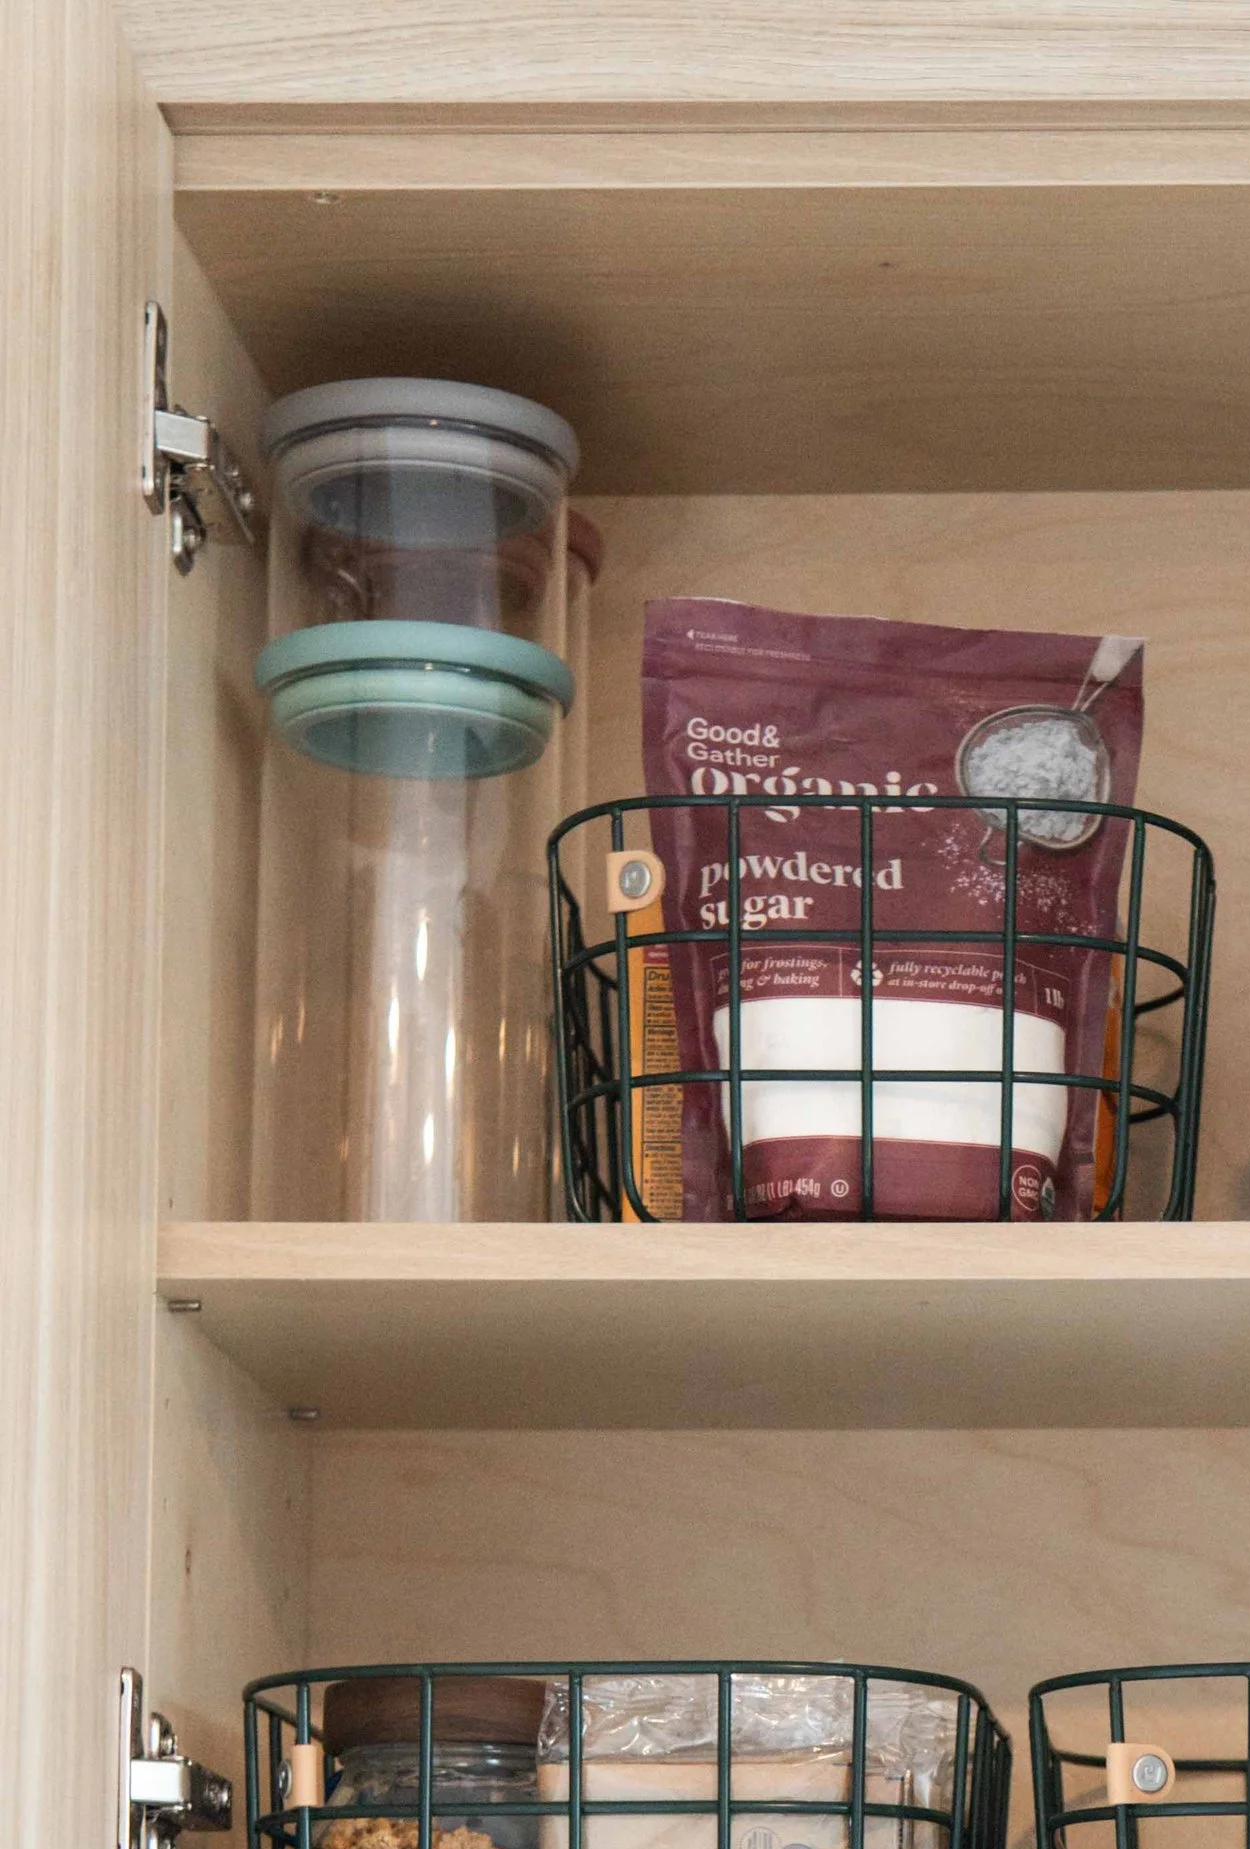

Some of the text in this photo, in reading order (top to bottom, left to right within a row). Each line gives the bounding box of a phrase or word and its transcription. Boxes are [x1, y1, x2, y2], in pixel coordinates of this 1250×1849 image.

[687, 717, 780, 748] Good&
[687, 742, 780, 768] Gather
[691, 766, 939, 823] organic
[699, 851, 904, 898] powdered
[773, 973, 819, 987] baking
[889, 961, 1027, 985] fully recyclable poch
[903, 978, 947, 990] in-store
[949, 980, 995, 996] drop-off
[795, 1178, 821, 1198] 454g
